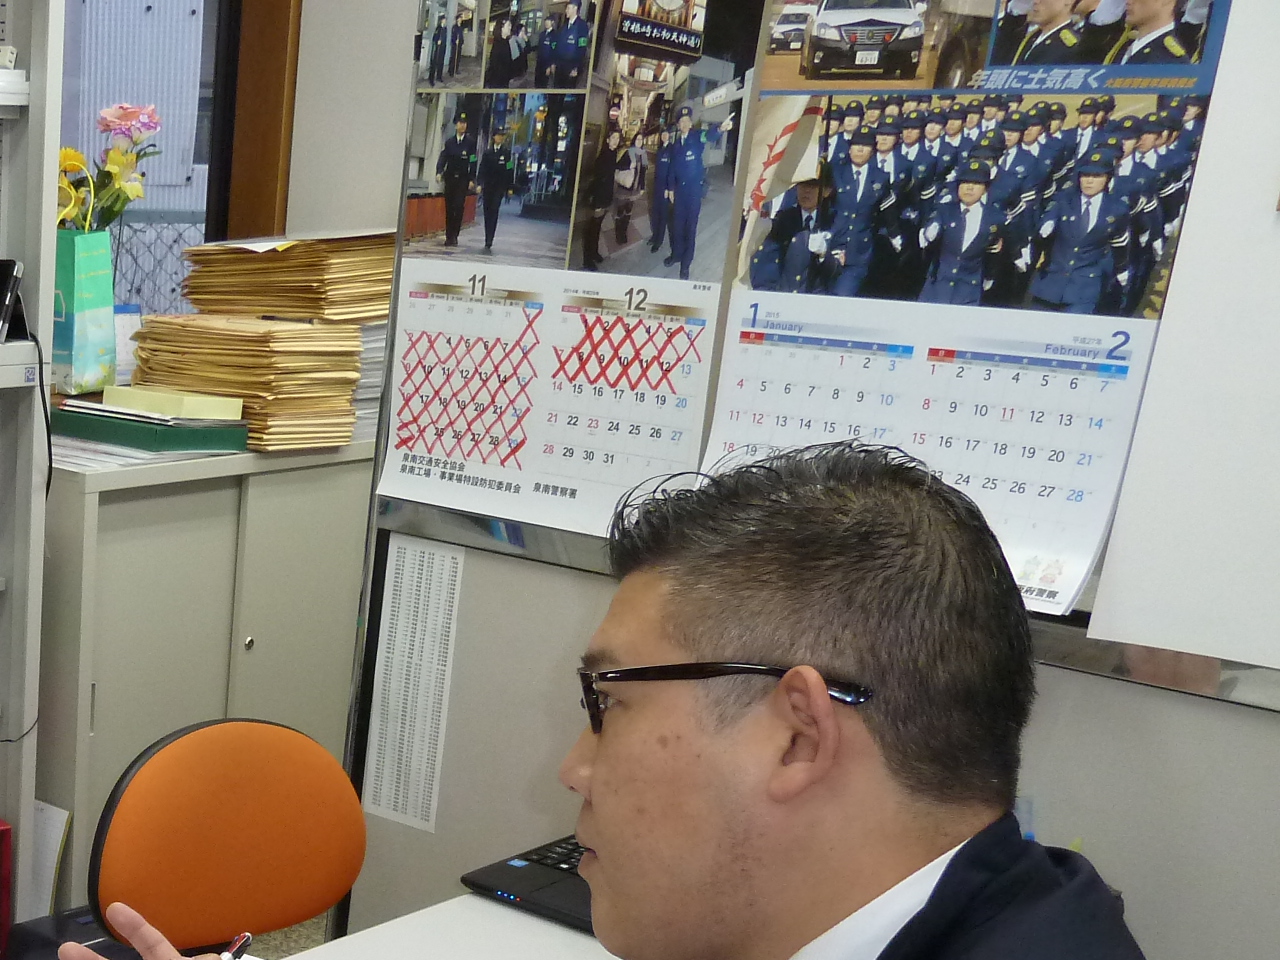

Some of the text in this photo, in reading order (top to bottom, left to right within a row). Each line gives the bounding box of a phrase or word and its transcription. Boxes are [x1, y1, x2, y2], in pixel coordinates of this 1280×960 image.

[968, 68, 1106, 90] 年頭に士気高く
[468, 273, 487, 297] 11
[624, 287, 649, 312] 12
[749, 302, 760, 328] 1
[763, 319, 804, 334] January
[1044, 343, 1100, 360] February
[1105, 330, 1131, 361] 2
[922, 398, 1104, 430] 8 9 10 11 12 13 14
[547, 412, 683, 441] 21 22 23 24 25 26 27
[401, 452, 466, 472] 泉南交通安全協会
[542, 443, 615, 464] 28 29 30 31
[532, 481, 578, 500] 泉南警察署
[954, 473, 1085, 502] 24 25 26 27 28
